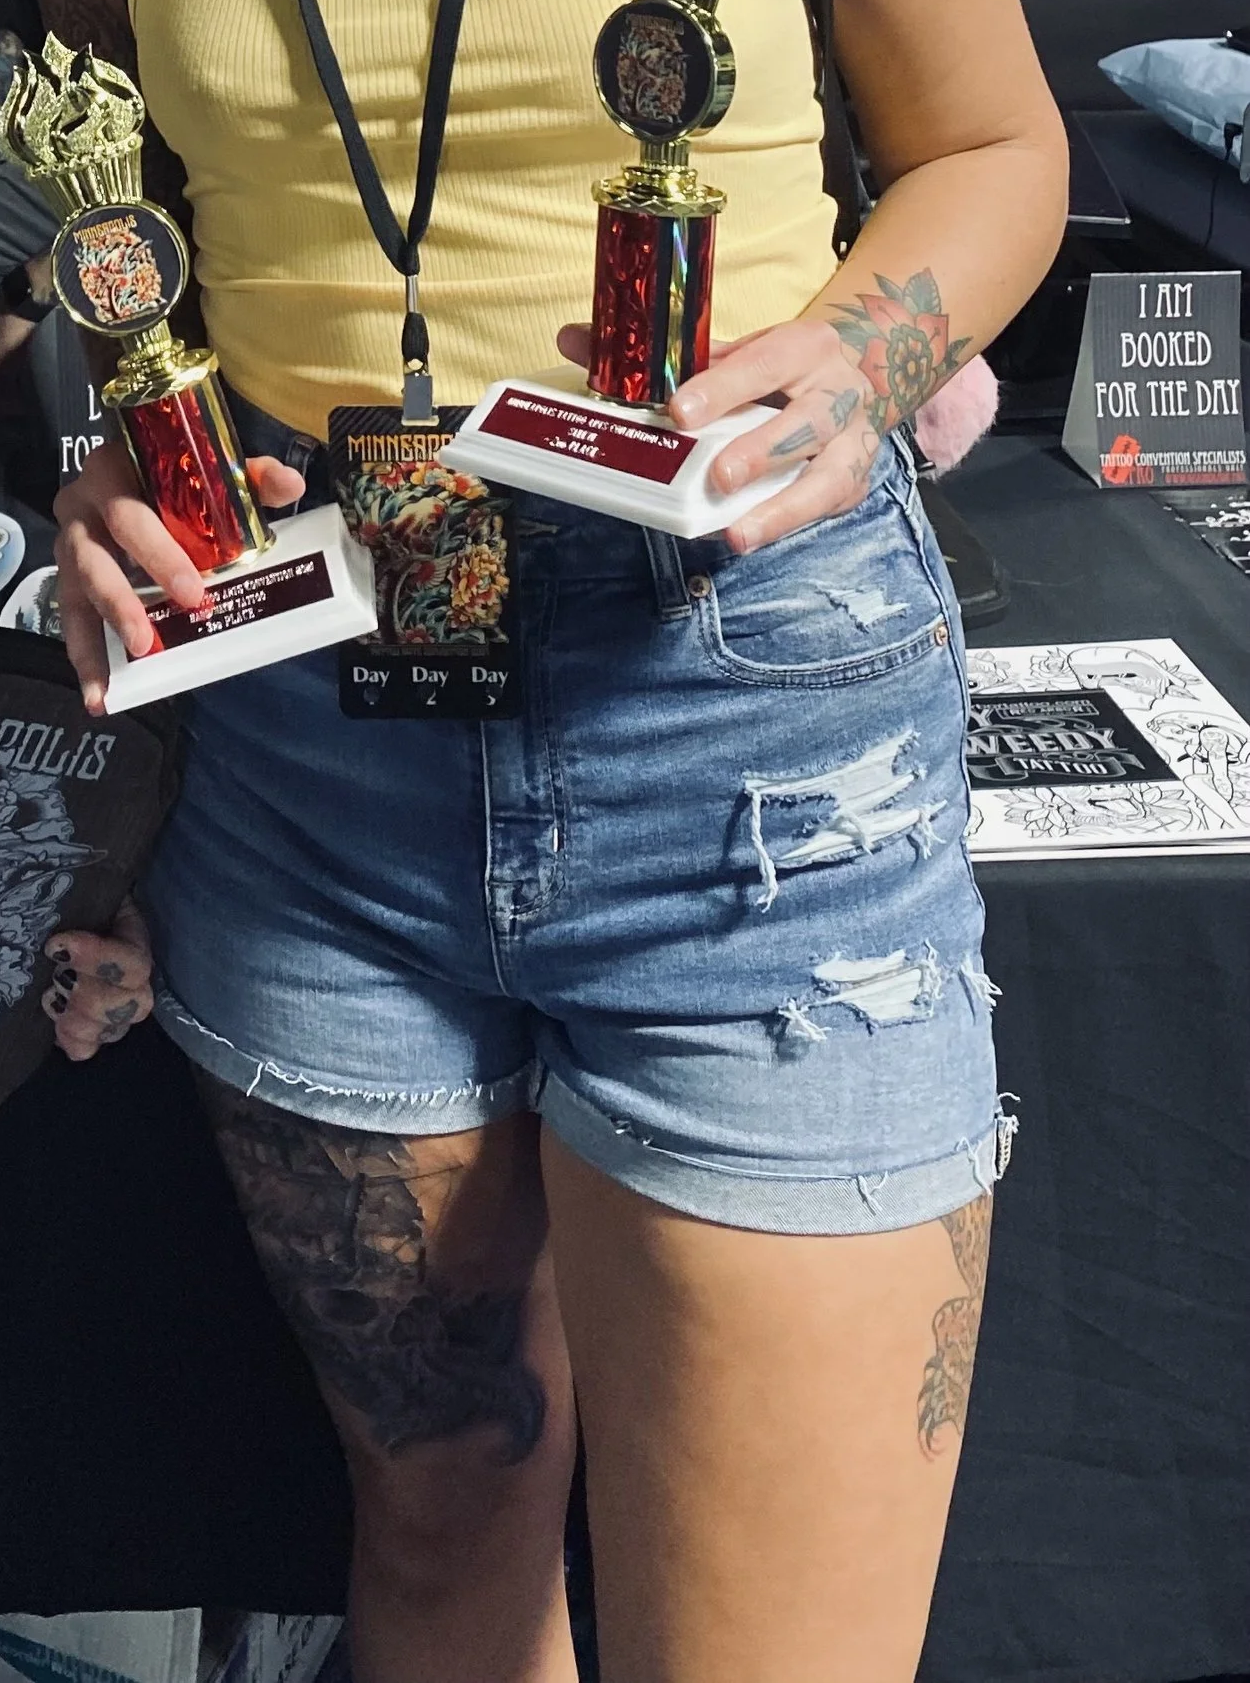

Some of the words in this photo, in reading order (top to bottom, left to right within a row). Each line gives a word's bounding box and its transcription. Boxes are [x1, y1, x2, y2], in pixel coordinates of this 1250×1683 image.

[1138, 282, 1147, 319] I
[1154, 282, 1193, 318] AM
[1120, 330, 1213, 368] BOOKED
[1095, 381, 1141, 418] FOR
[1146, 380, 1190, 417] THE
[1195, 379, 1241, 416] DAY
[347, 432, 454, 462] MINNEAP
[1100, 453, 1133, 467] TATTOO
[1134, 451, 1191, 467] CONVENTION
[1192, 450, 1247, 465] SPECIALISTS
[353, 666, 390, 687] Day
[412, 666, 449, 687] Day
[471, 666, 509, 687] Day
[966, 728, 1117, 756] WEEDY
[1013, 757, 1108, 775] TATTOO
